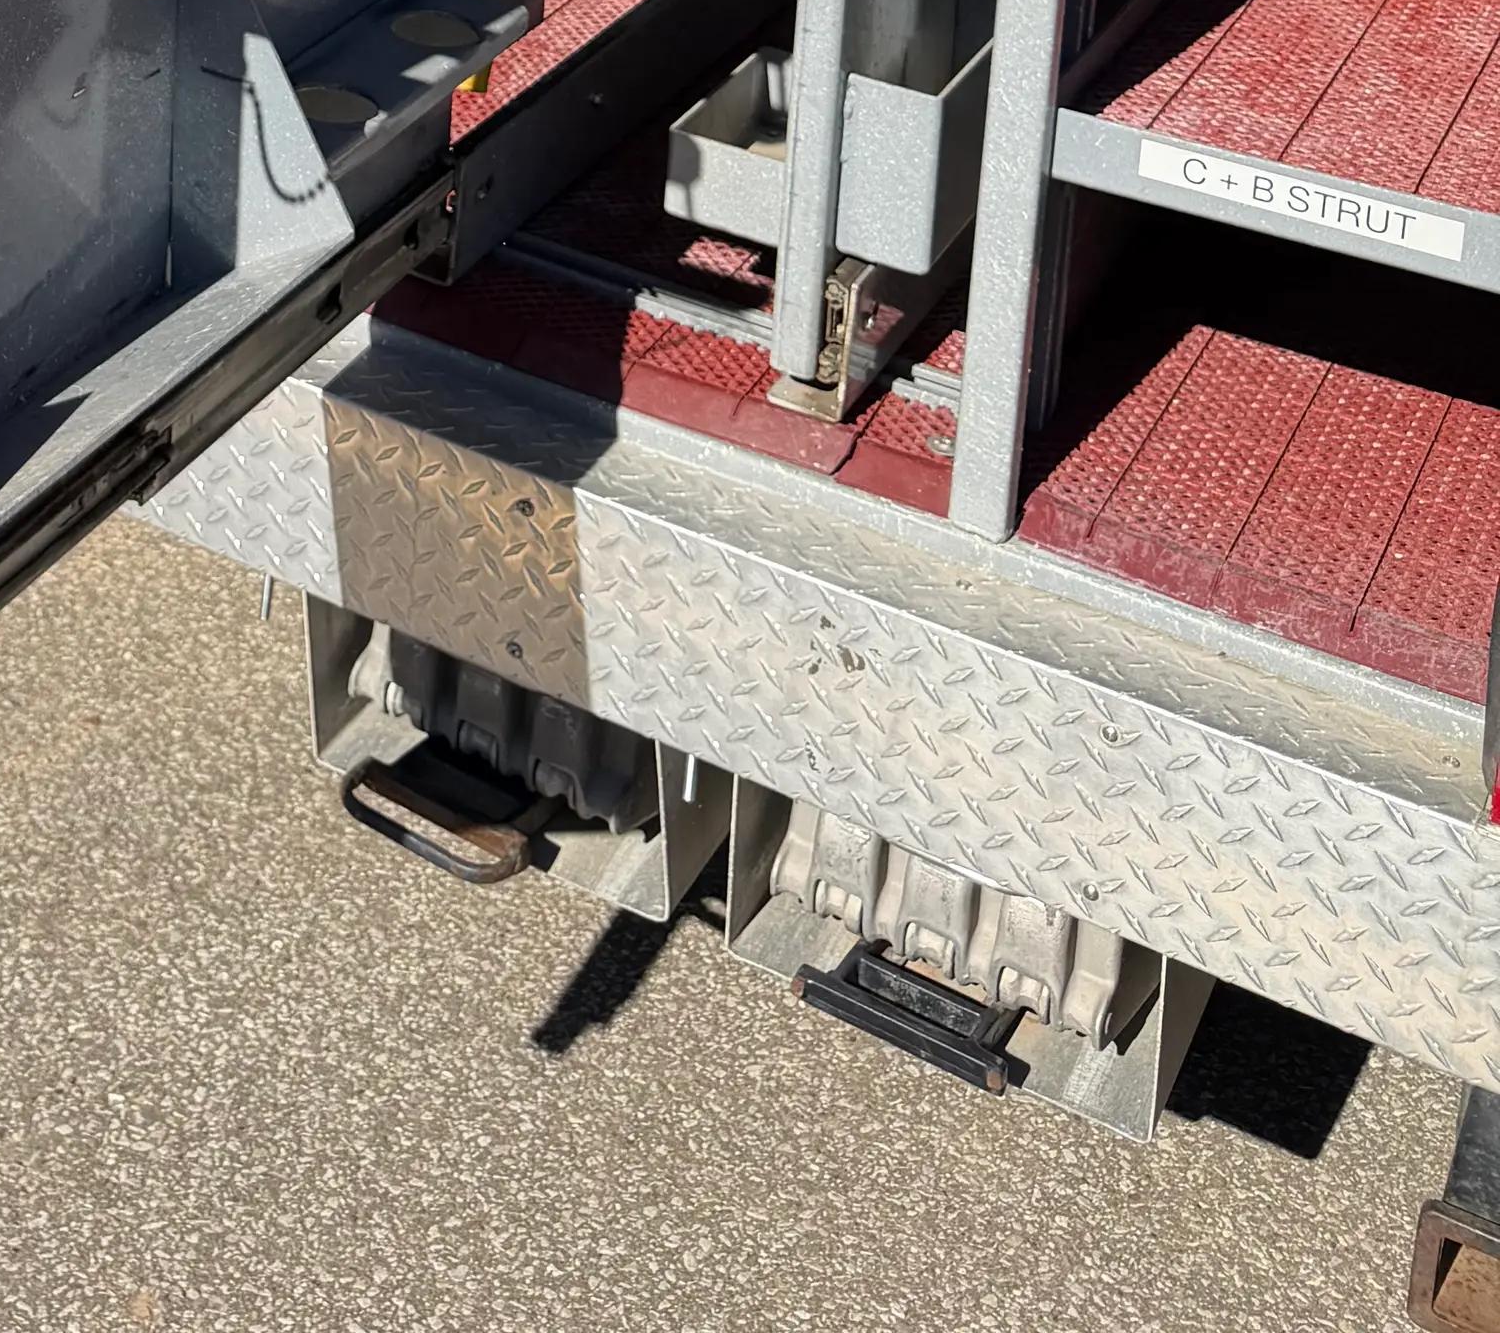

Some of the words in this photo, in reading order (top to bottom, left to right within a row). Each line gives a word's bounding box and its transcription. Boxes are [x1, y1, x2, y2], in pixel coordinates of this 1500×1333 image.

[1182, 158, 1208, 185] C
[1219, 174, 1239, 190] +
[1251, 175, 1274, 203] B
[1286, 185, 1416, 240] STRUT
